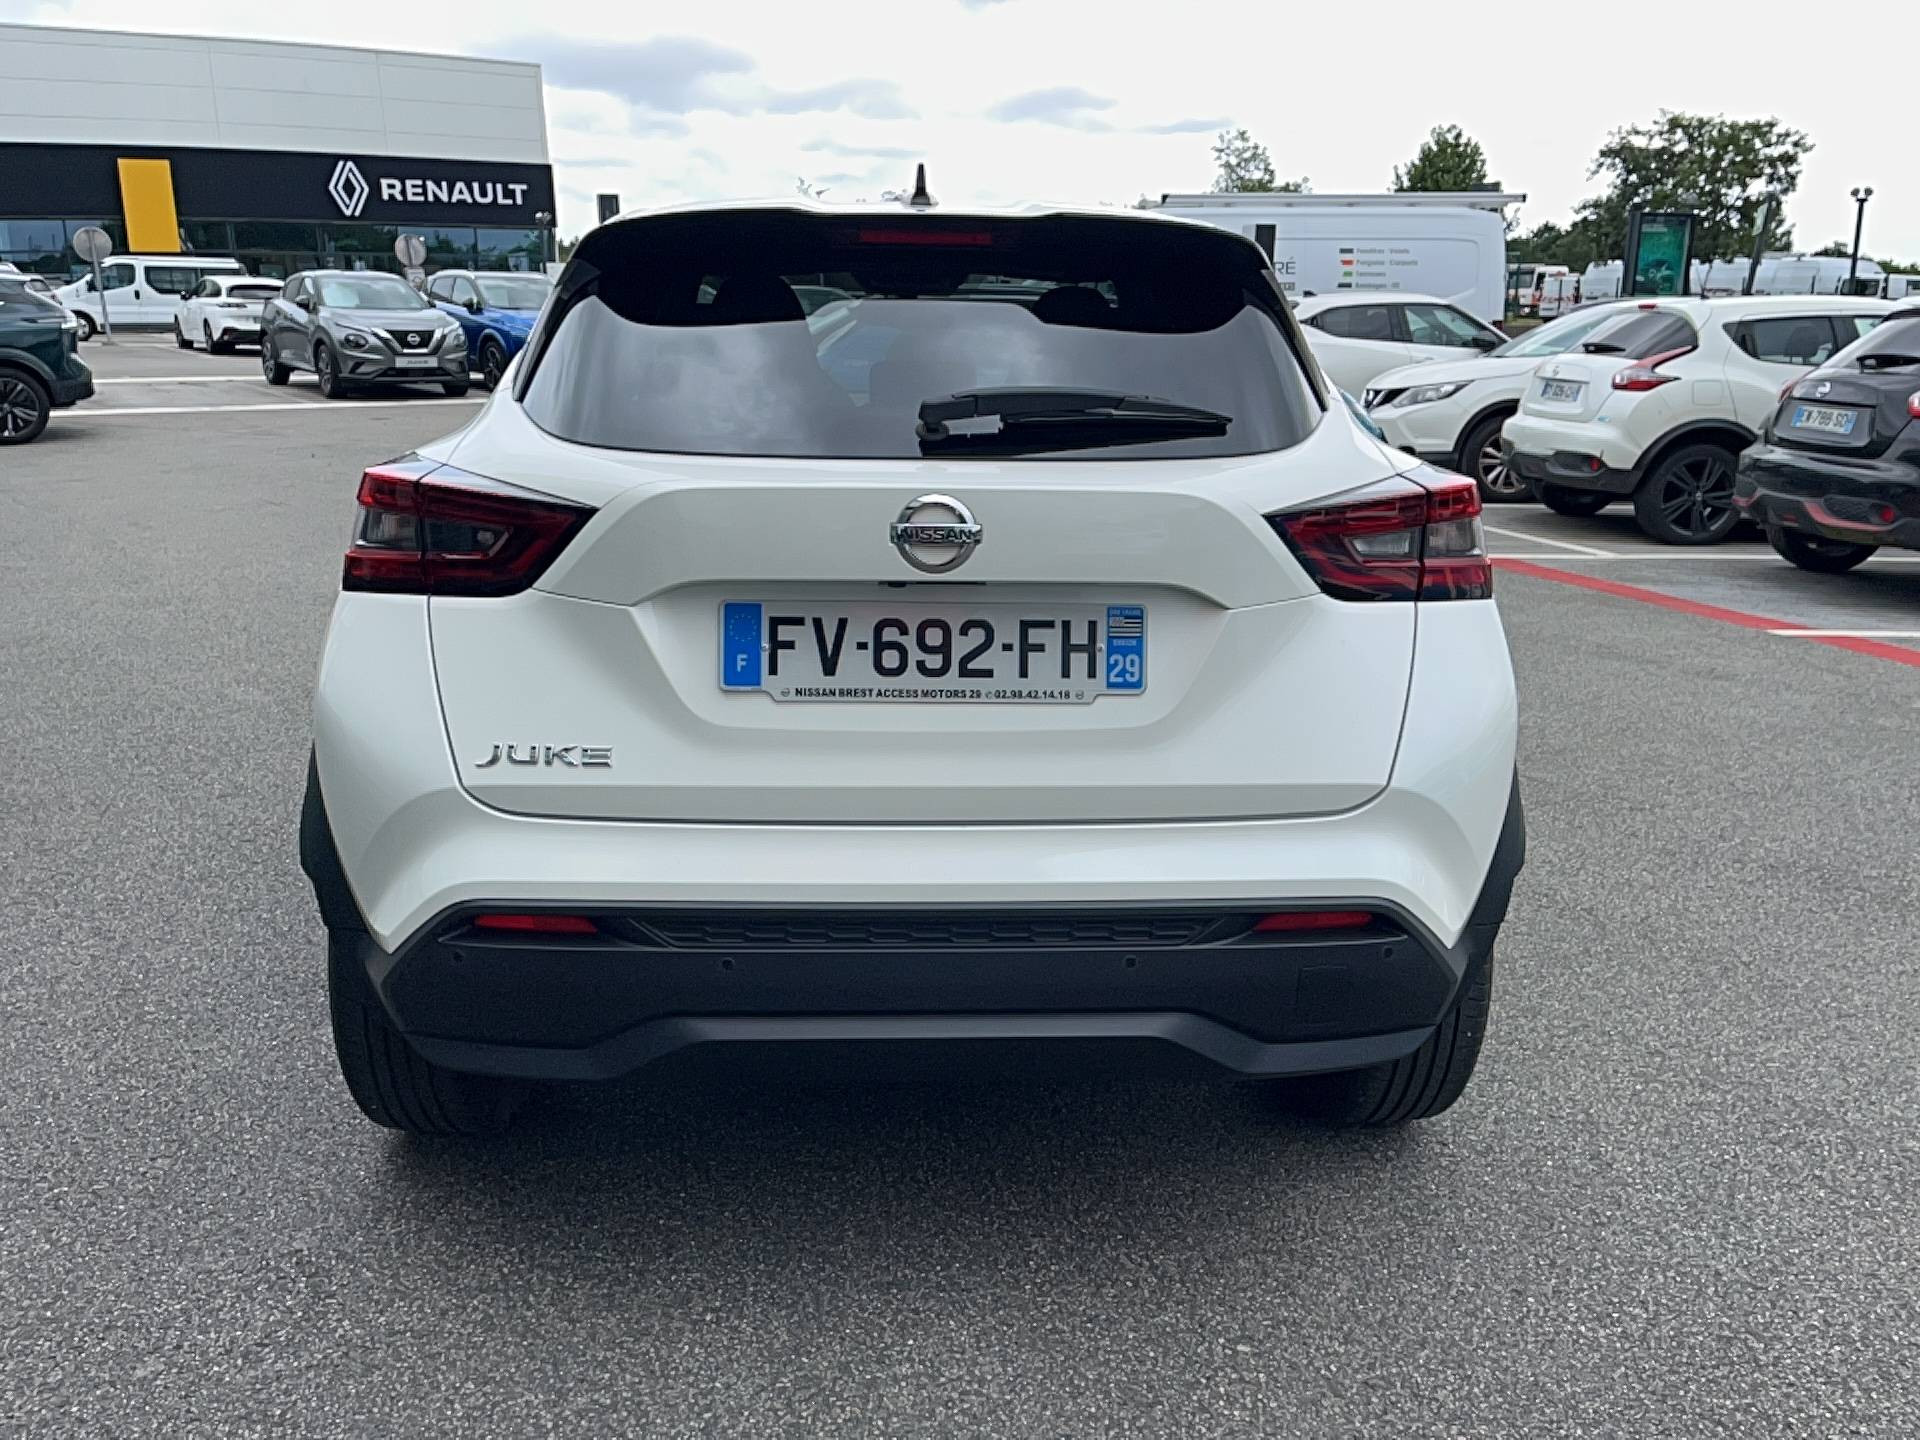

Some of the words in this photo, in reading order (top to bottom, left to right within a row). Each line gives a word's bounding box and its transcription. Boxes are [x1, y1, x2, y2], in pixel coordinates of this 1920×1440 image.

[379, 177, 528, 206] RENAULT
[896, 526, 977, 541] NISSAN
[767, 615, 1098, 680] FV-692-FH
[736, 653, 748, 672] F
[1108, 653, 1141, 683] 29
[795, 687, 836, 698] NISSAN
[838, 688, 875, 698] BREST
[875, 688, 919, 698] ACCESS
[920, 689, 967, 699] MOTORS
[474, 742, 613, 769] JUKE
